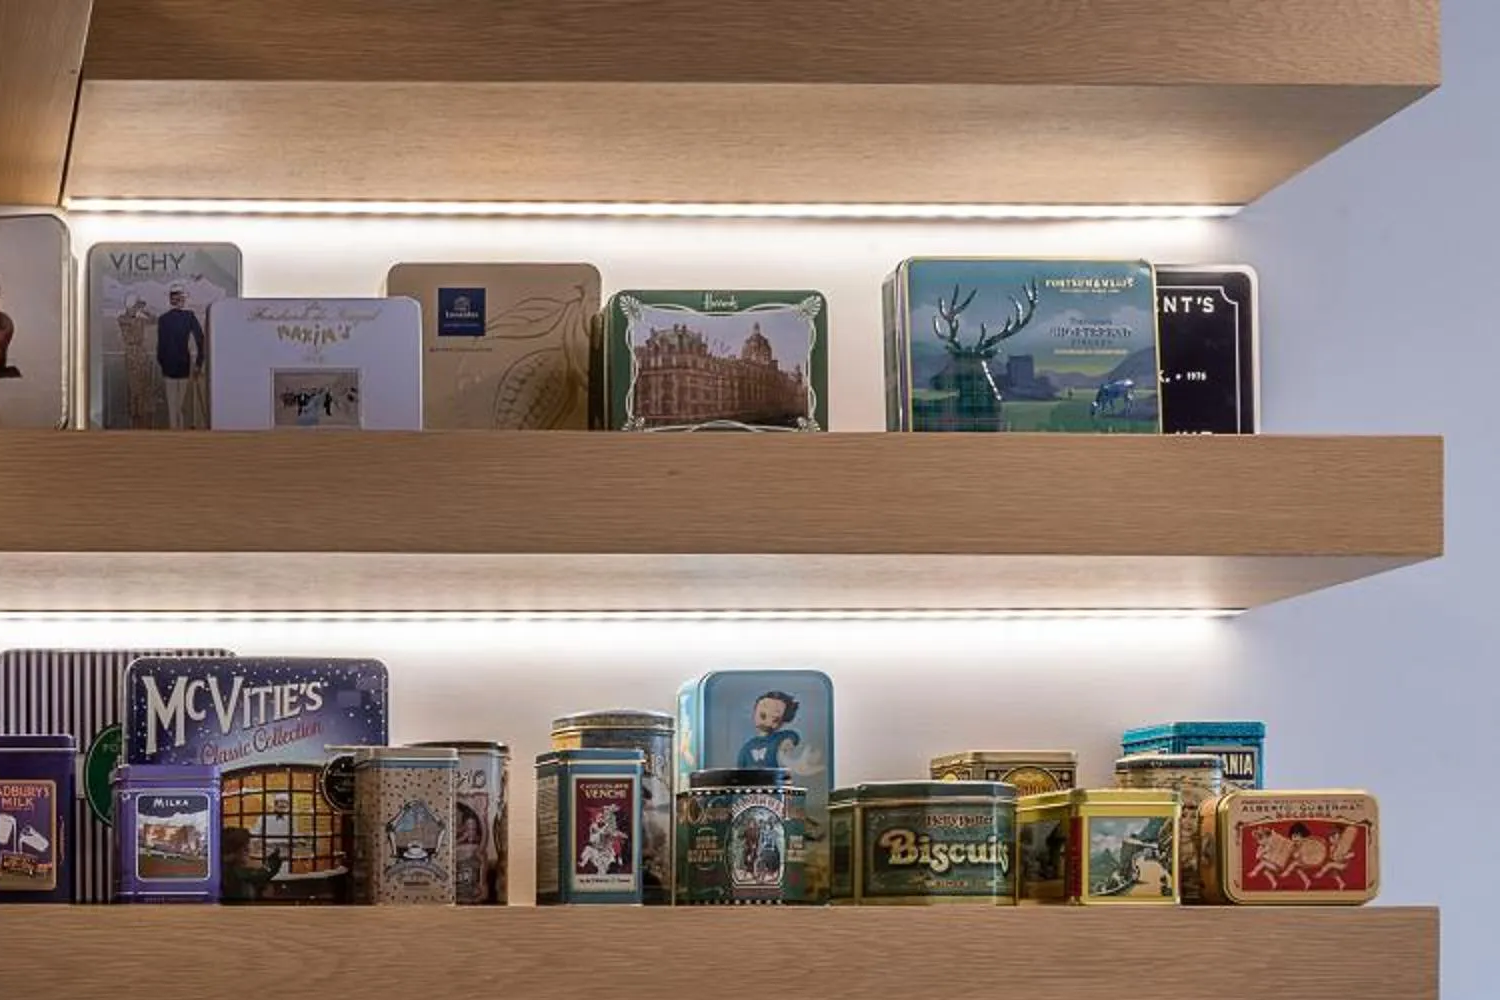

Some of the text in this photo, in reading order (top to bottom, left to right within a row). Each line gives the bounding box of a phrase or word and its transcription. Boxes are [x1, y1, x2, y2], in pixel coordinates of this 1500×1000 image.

[109, 252, 186, 271] VICHY
[202, 718, 324, 765] Classic Collection
[2, 797, 33, 807] MILK
[153, 797, 189, 807] MILKA
